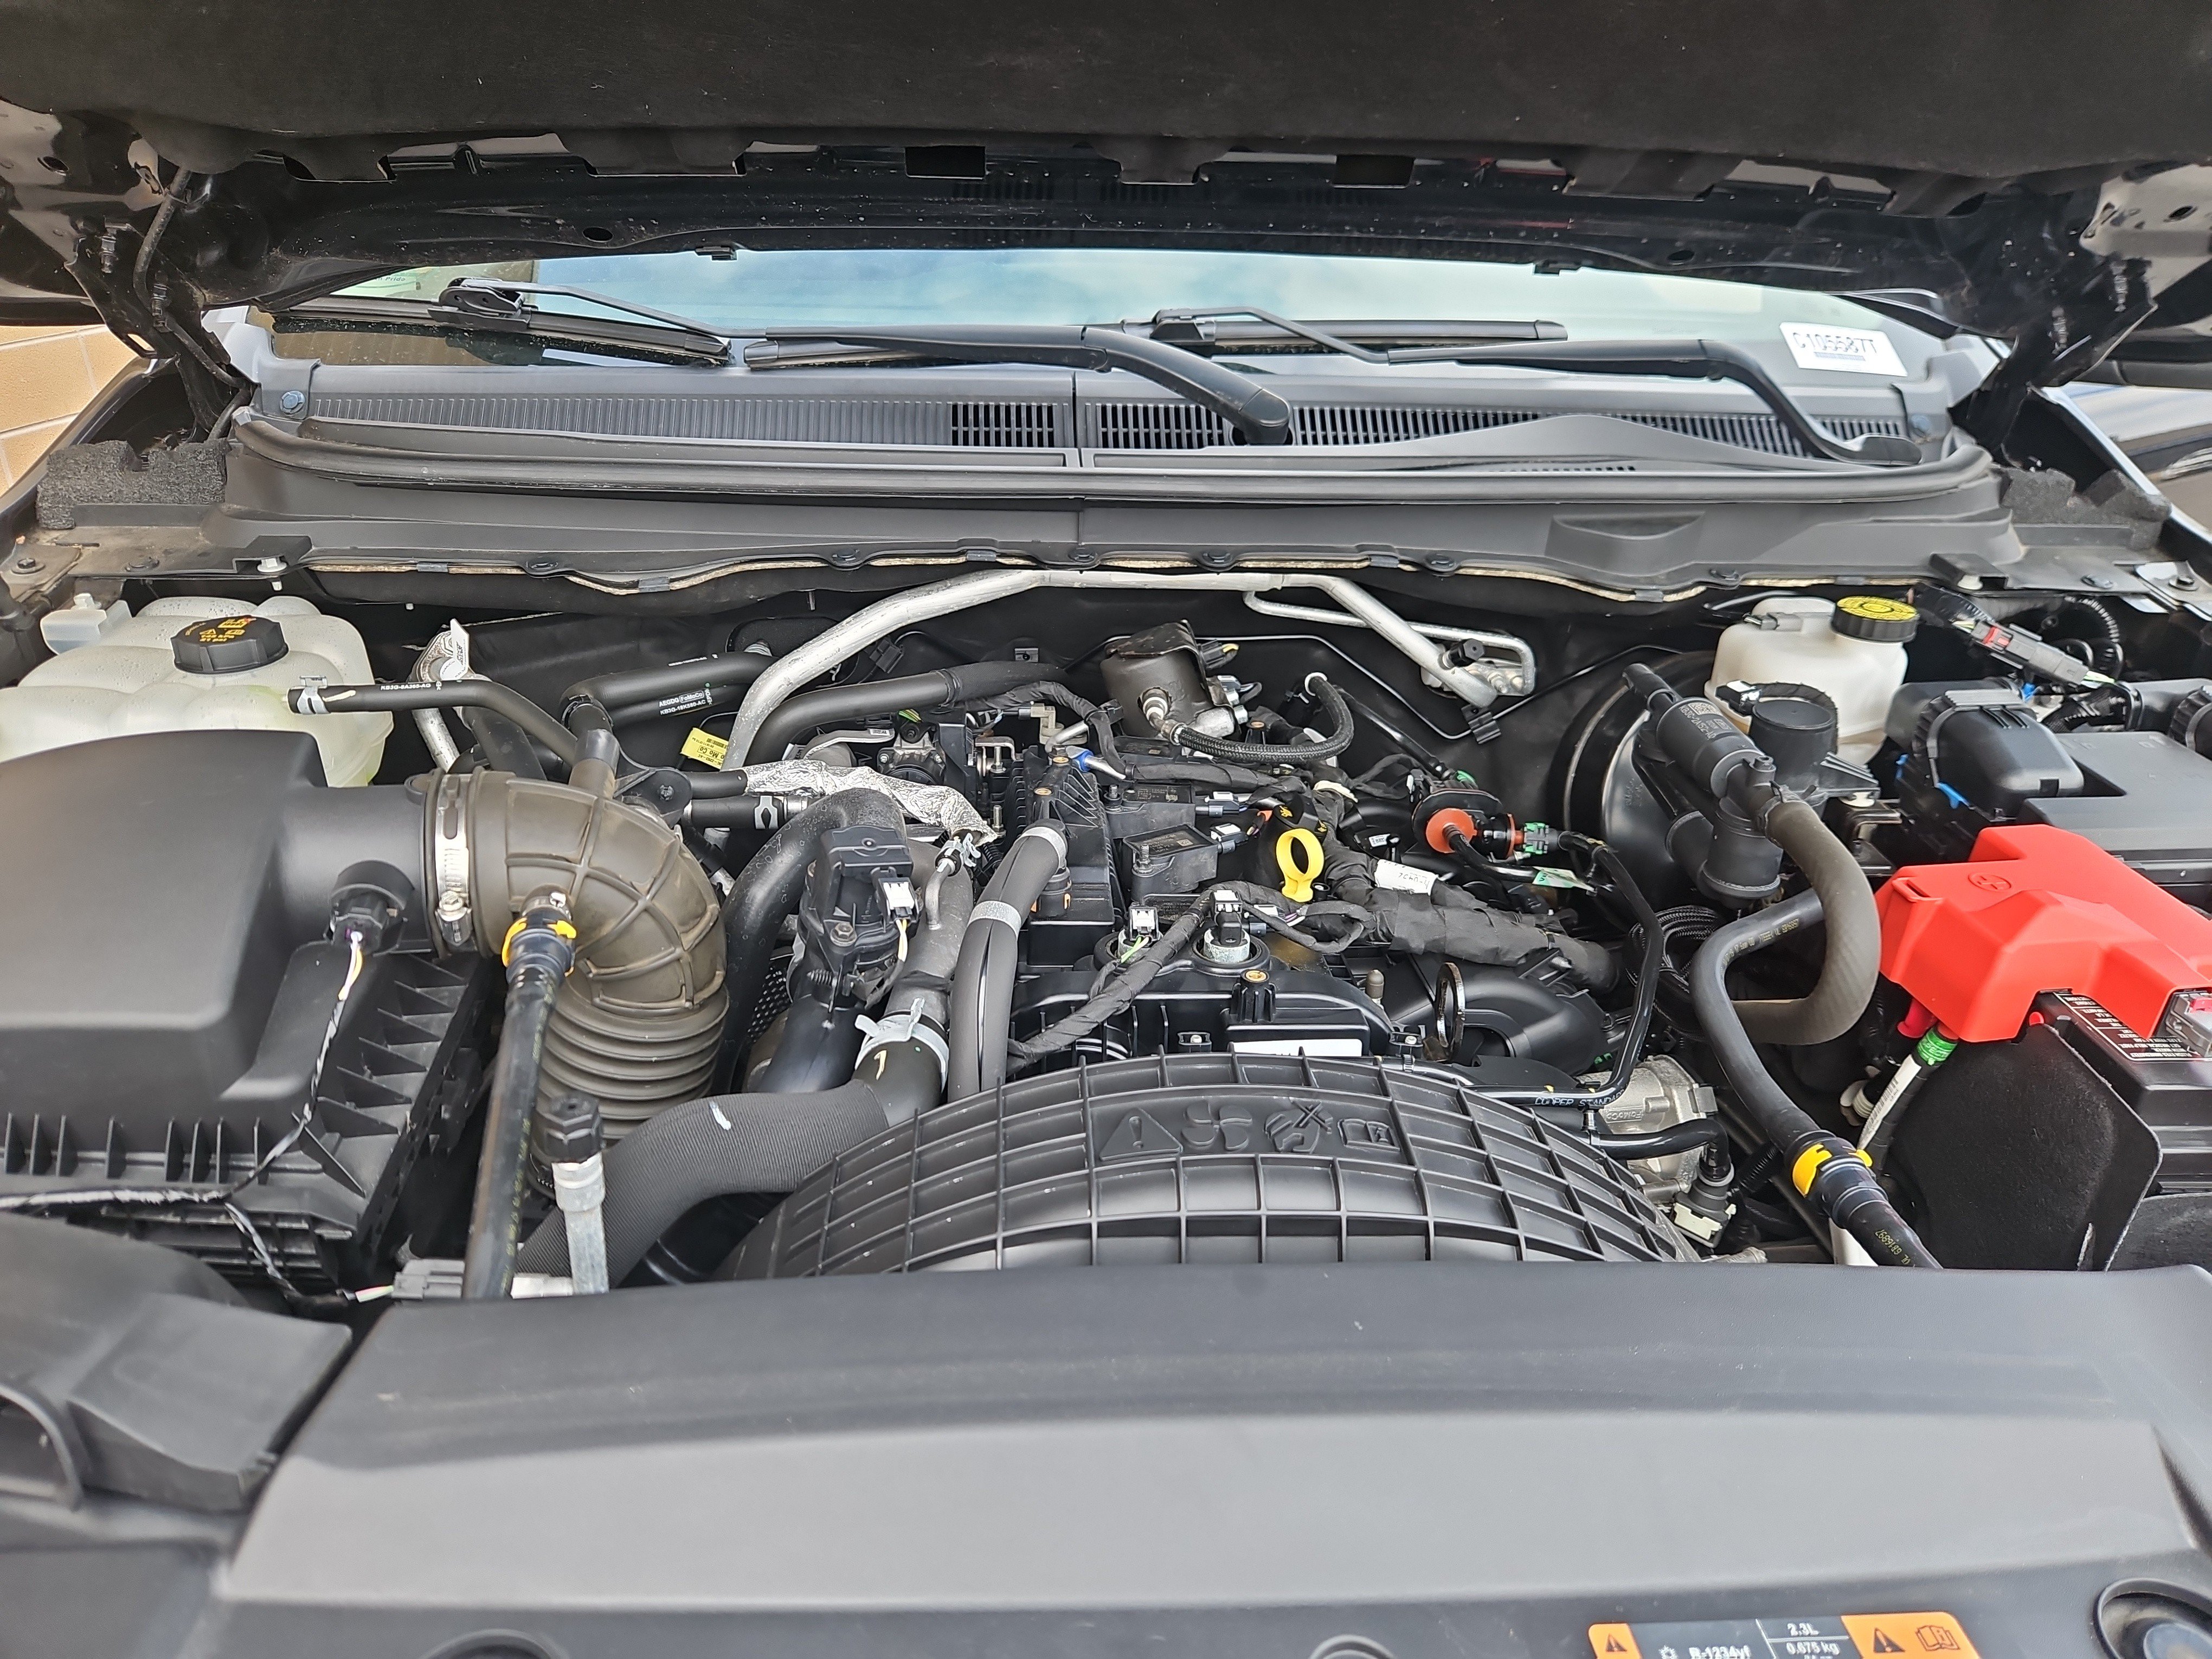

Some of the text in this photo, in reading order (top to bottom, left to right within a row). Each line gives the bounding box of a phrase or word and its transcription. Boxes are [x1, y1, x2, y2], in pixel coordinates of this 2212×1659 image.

[680, 692, 703, 702] FoMoCo
[1787, 1623, 1819, 1636] 2.3L
[1821, 1642, 1840, 1655] kg
